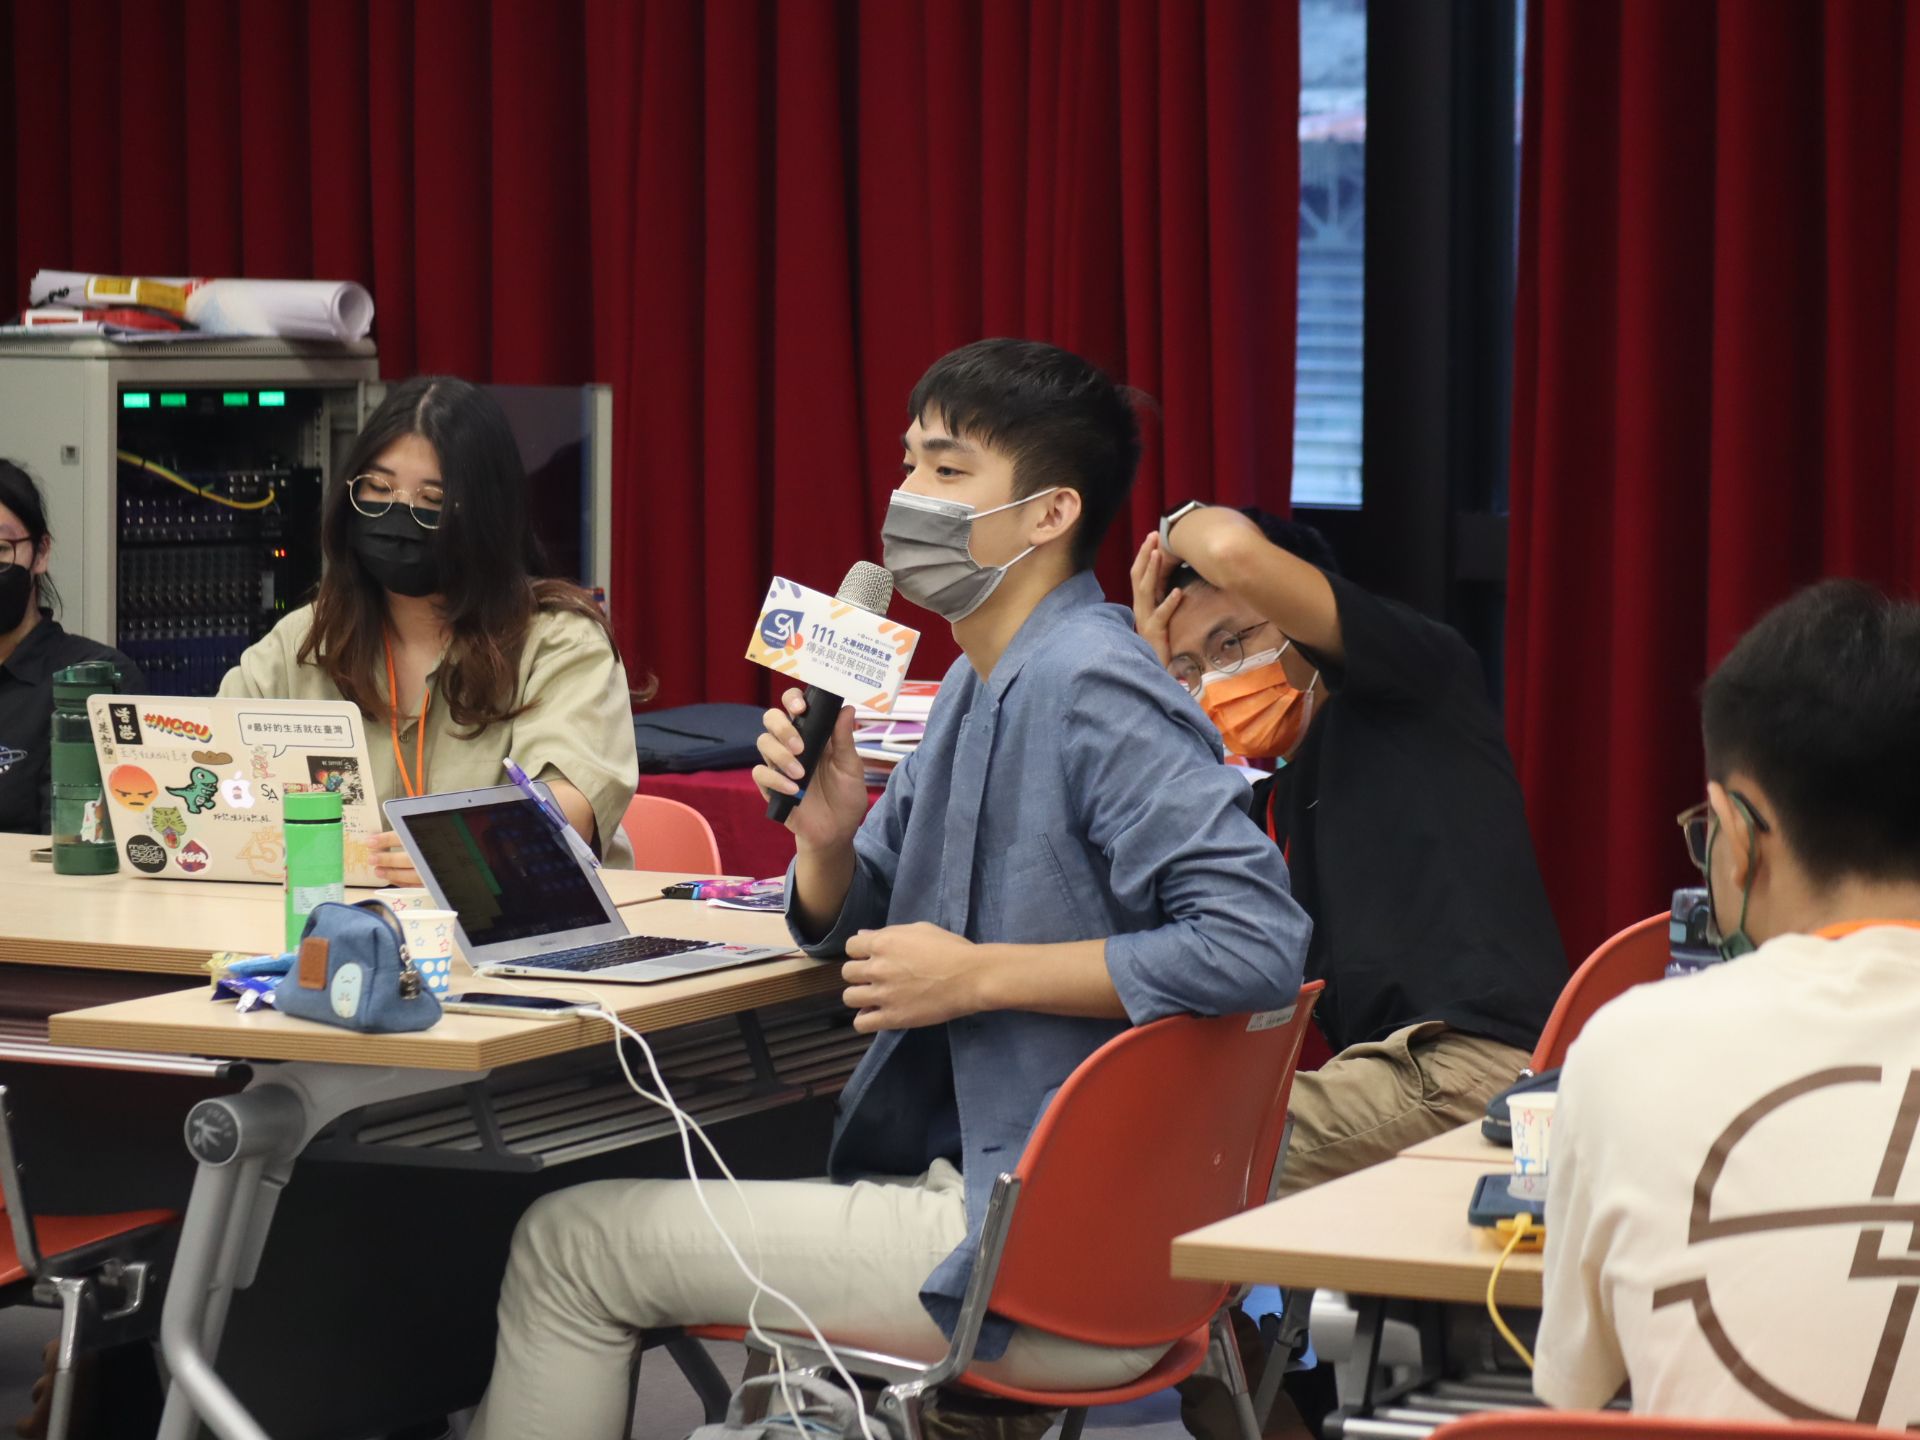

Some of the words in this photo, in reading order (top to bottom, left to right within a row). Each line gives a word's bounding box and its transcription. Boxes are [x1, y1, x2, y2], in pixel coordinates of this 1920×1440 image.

[806, 641, 887, 681] 傳承與發展研習營
[839, 645, 861, 658] Student
[860, 653, 889, 668] Association
[843, 636, 892, 662] 大專校院學生會
[143, 713, 213, 743] #NCCU
[248, 723, 343, 734] #最好的生活就在臺灣
